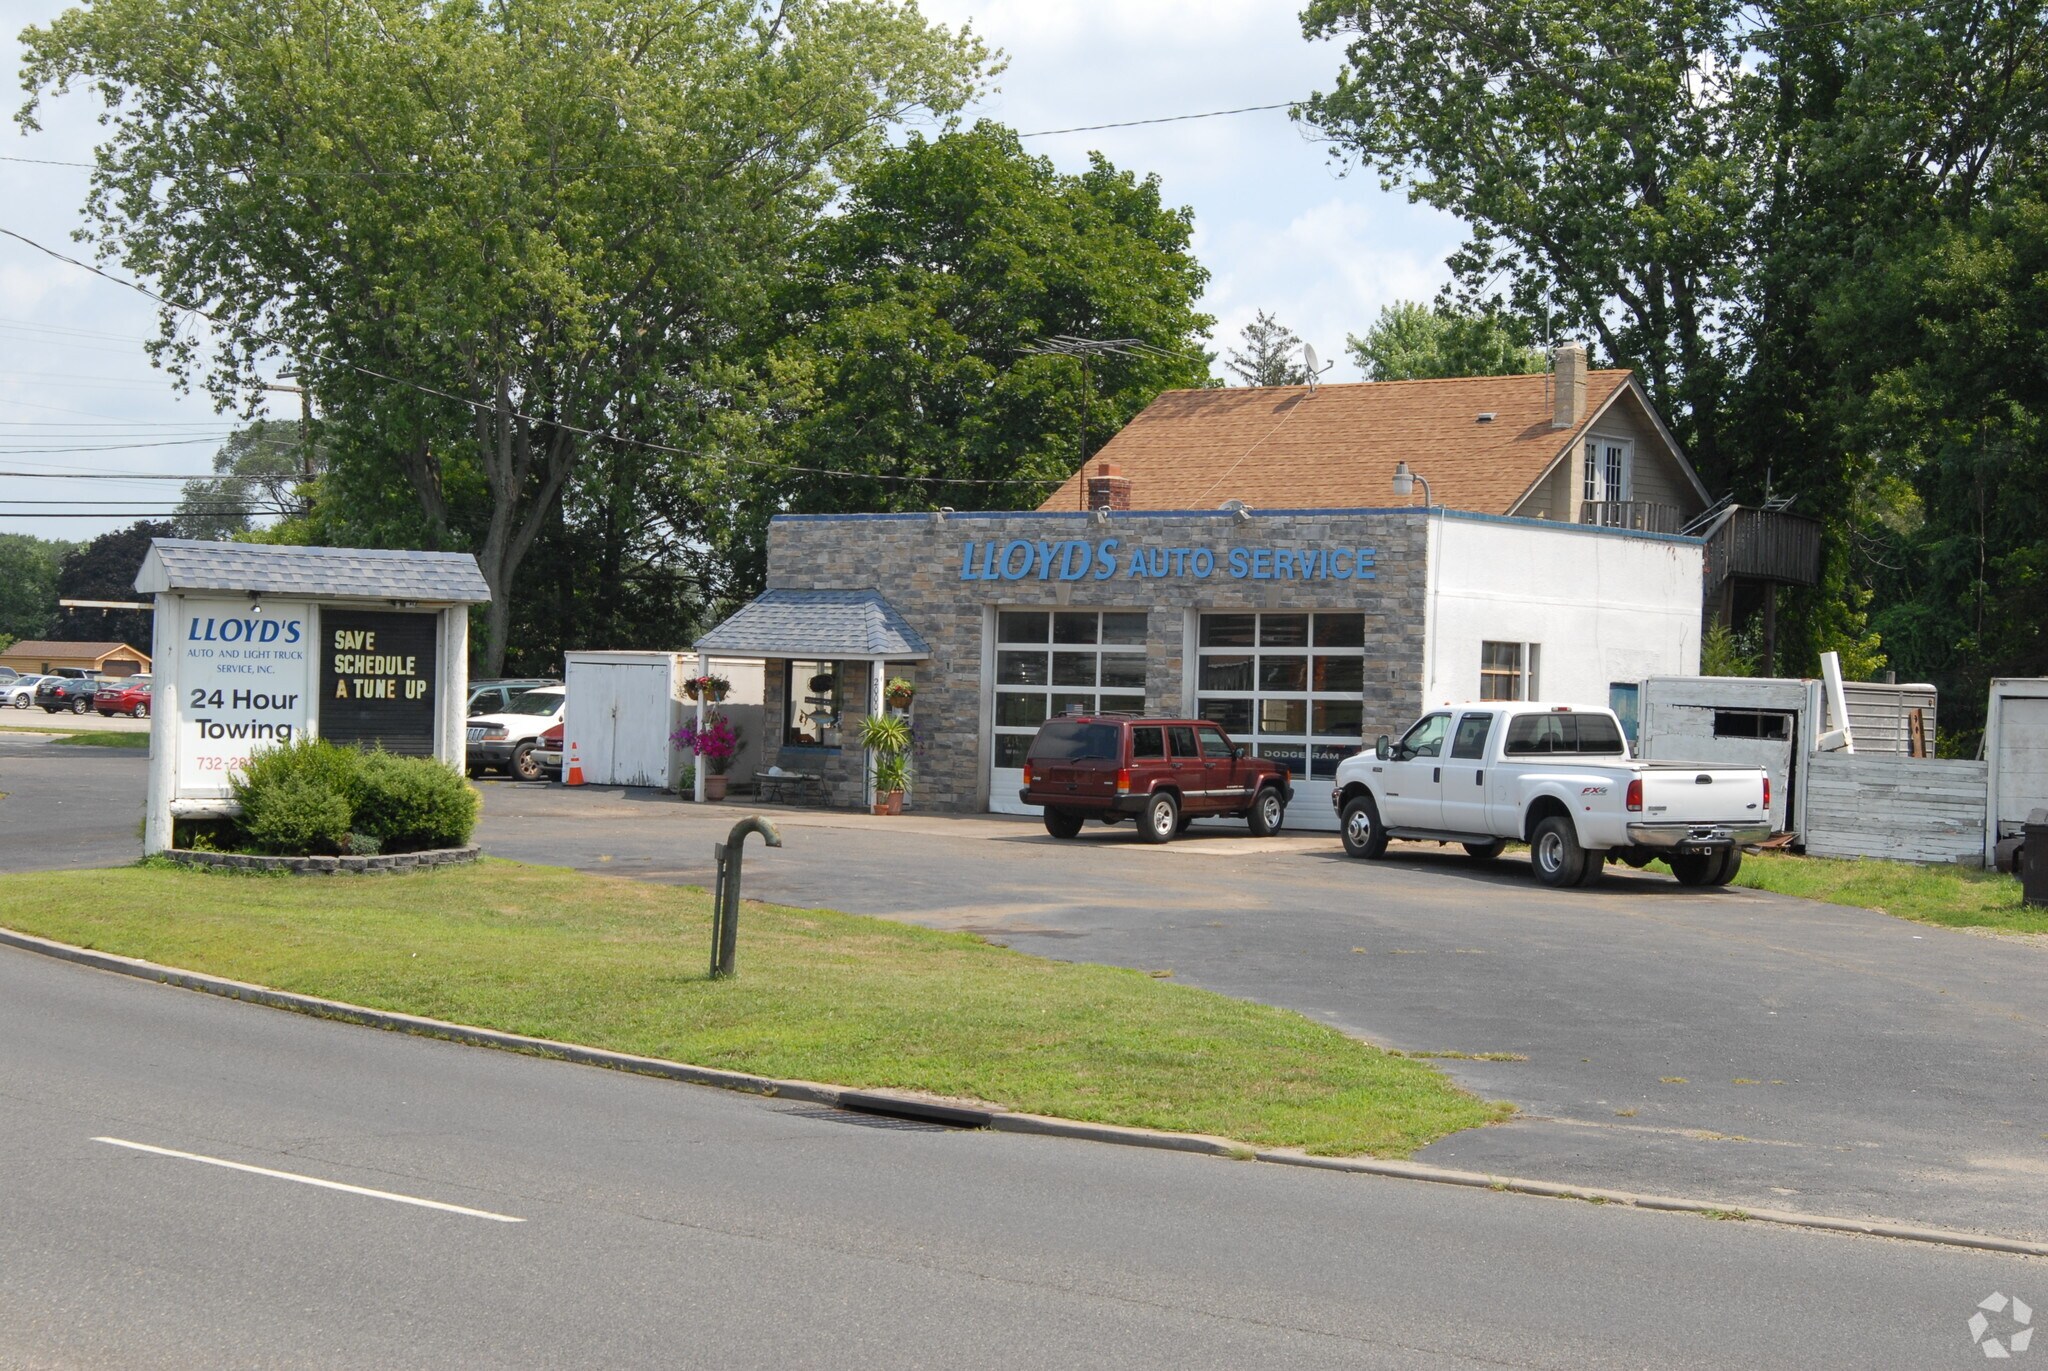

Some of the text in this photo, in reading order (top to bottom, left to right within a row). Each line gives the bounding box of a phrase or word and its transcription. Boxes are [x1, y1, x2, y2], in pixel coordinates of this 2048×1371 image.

[1128, 546, 1215, 579] AUTO
[1228, 546, 1377, 580] SERVICE
[188, 617, 301, 643] LLOYD'S
[334, 629, 376, 651] SAVE
[187, 649, 303, 660] AUTO AND LIGHT TRUCK
[334, 654, 416, 676] SCHEDULE
[216, 664, 275, 674] SERVICE, INC.
[190, 688, 299, 710] 24 Hour
[335, 678, 427, 699] A TUNE UP
[195, 718, 293, 744] Towing
[1263, 750, 1340, 760] DODGE RAM
